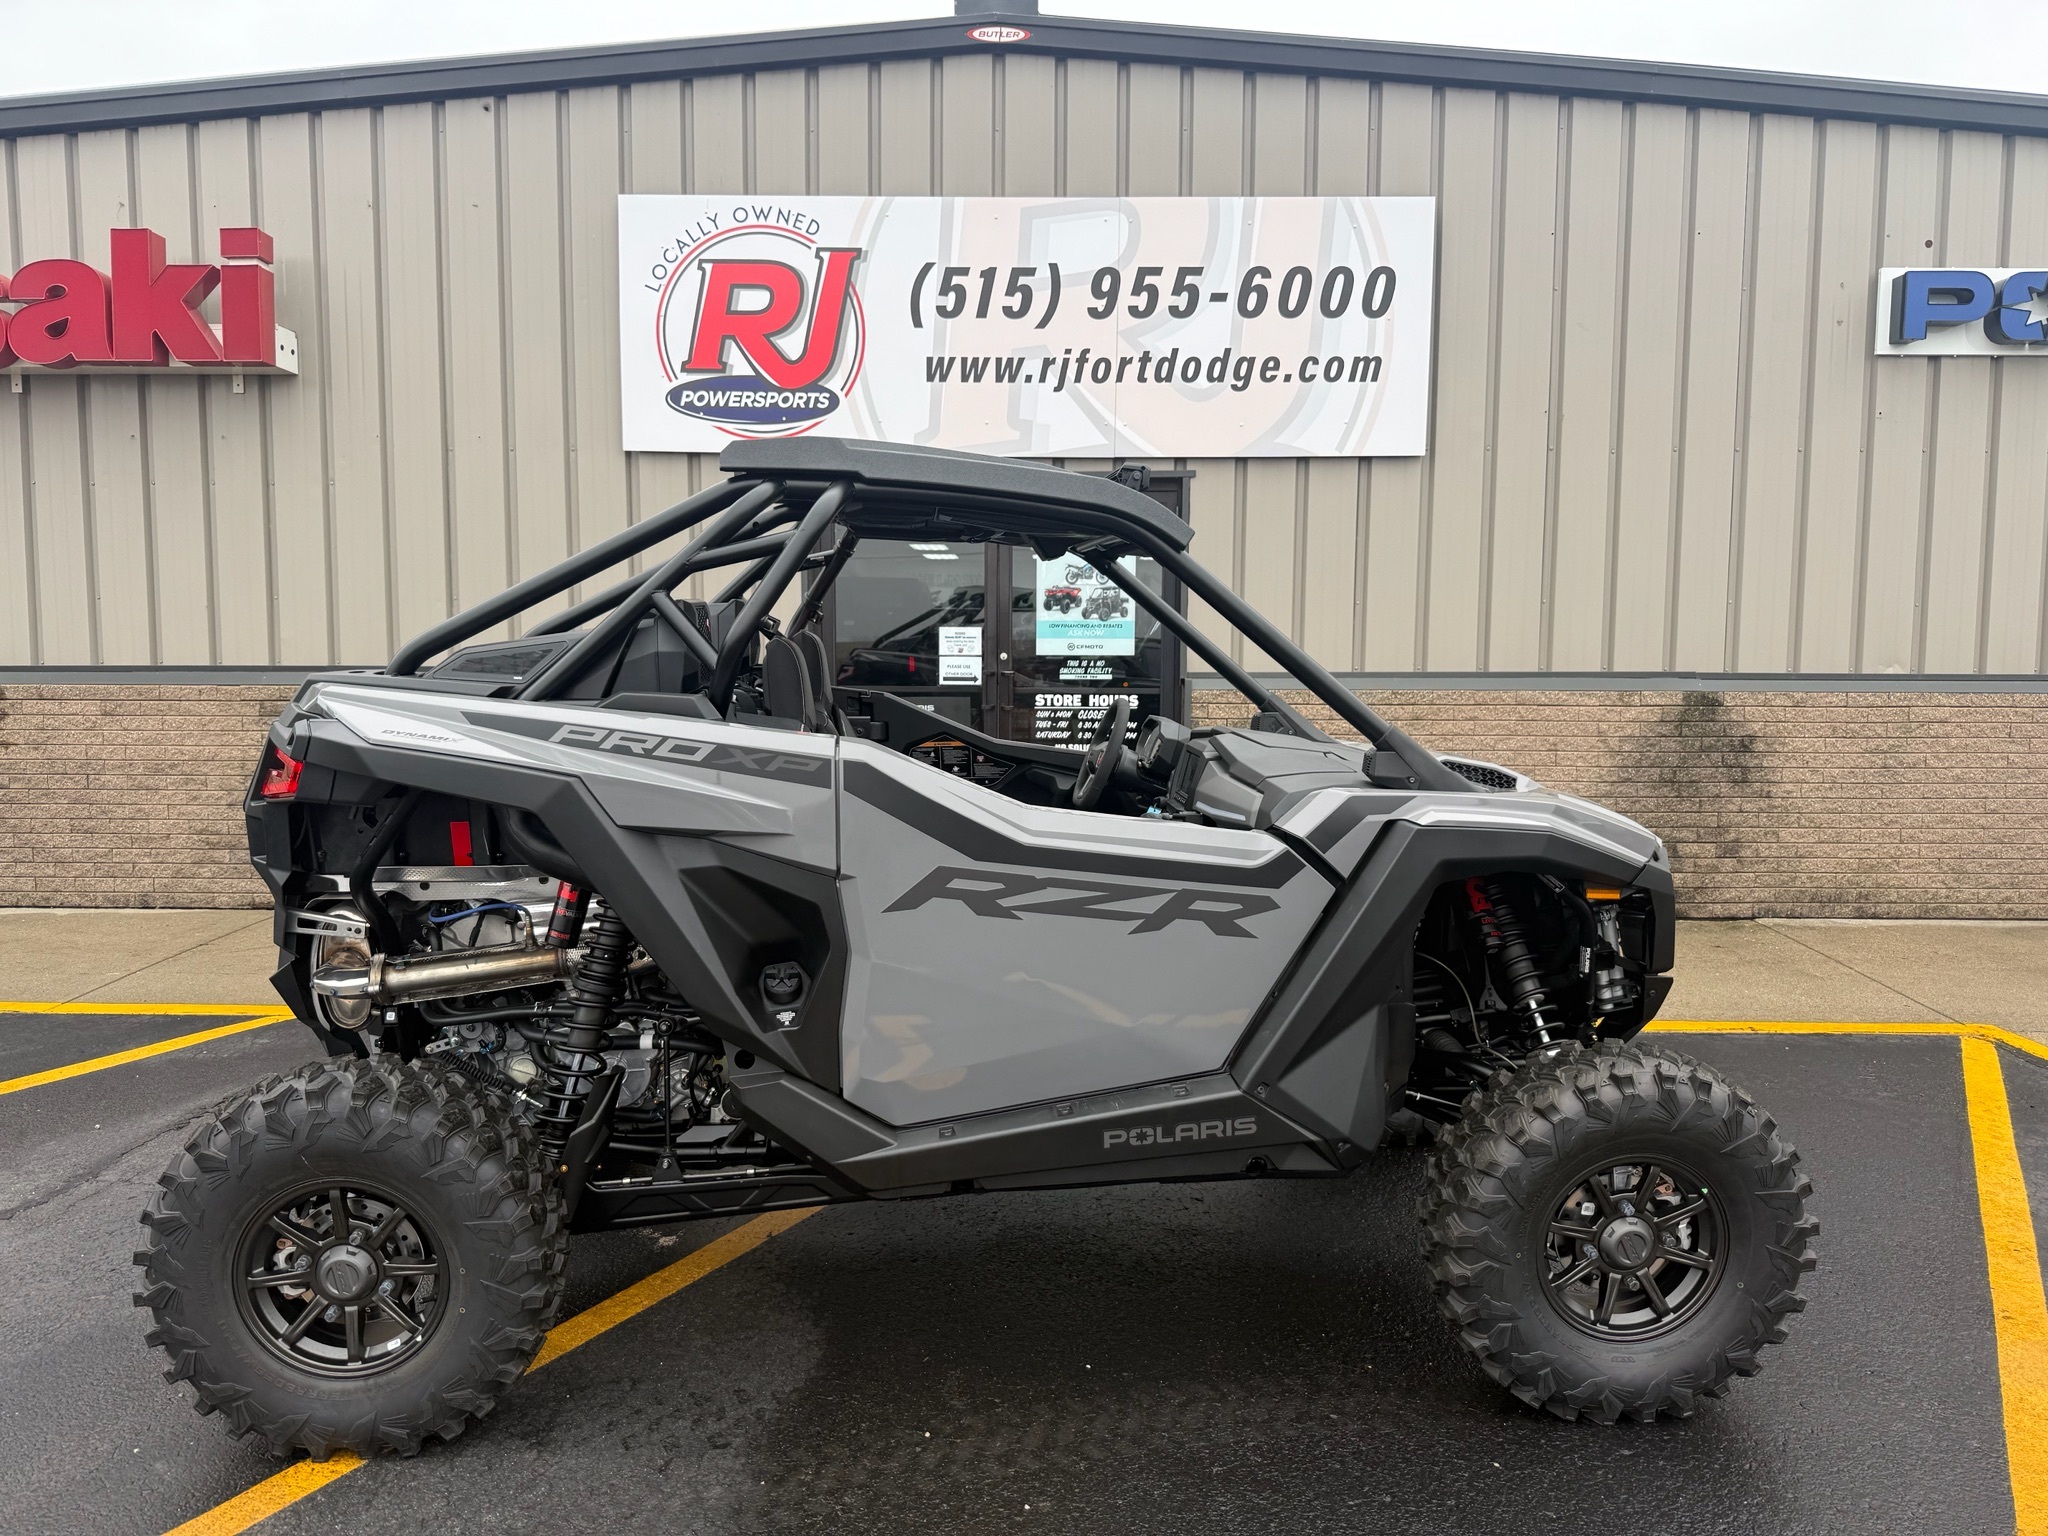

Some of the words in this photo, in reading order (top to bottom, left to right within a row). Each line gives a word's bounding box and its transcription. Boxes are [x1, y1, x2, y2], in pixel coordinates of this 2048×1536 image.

[645, 212, 721, 293] LOCALLY
[733, 205, 821, 237] OWNED
[0, 228, 273, 366] aki
[681, 247, 863, 390] RJ
[909, 261, 1062, 330] (515)
[1086, 265, 1398, 320] 955-6000
[924, 347, 1383, 393] www.rjfortdodge.com
[680, 389, 831, 410] POWERSPORTS
[1035, 694, 1082, 706] STORE
[1036, 710, 1051, 718] SUN
[1078, 709, 1108, 719] CLOSE
[547, 724, 718, 762] PRO
[721, 746, 824, 775] XP
[1035, 731, 1072, 739] SATURDAY
[1124, 731, 1138, 739] PM
[880, 865, 1282, 939] RZR
[1103, 1116, 1258, 1149] POLARIS
